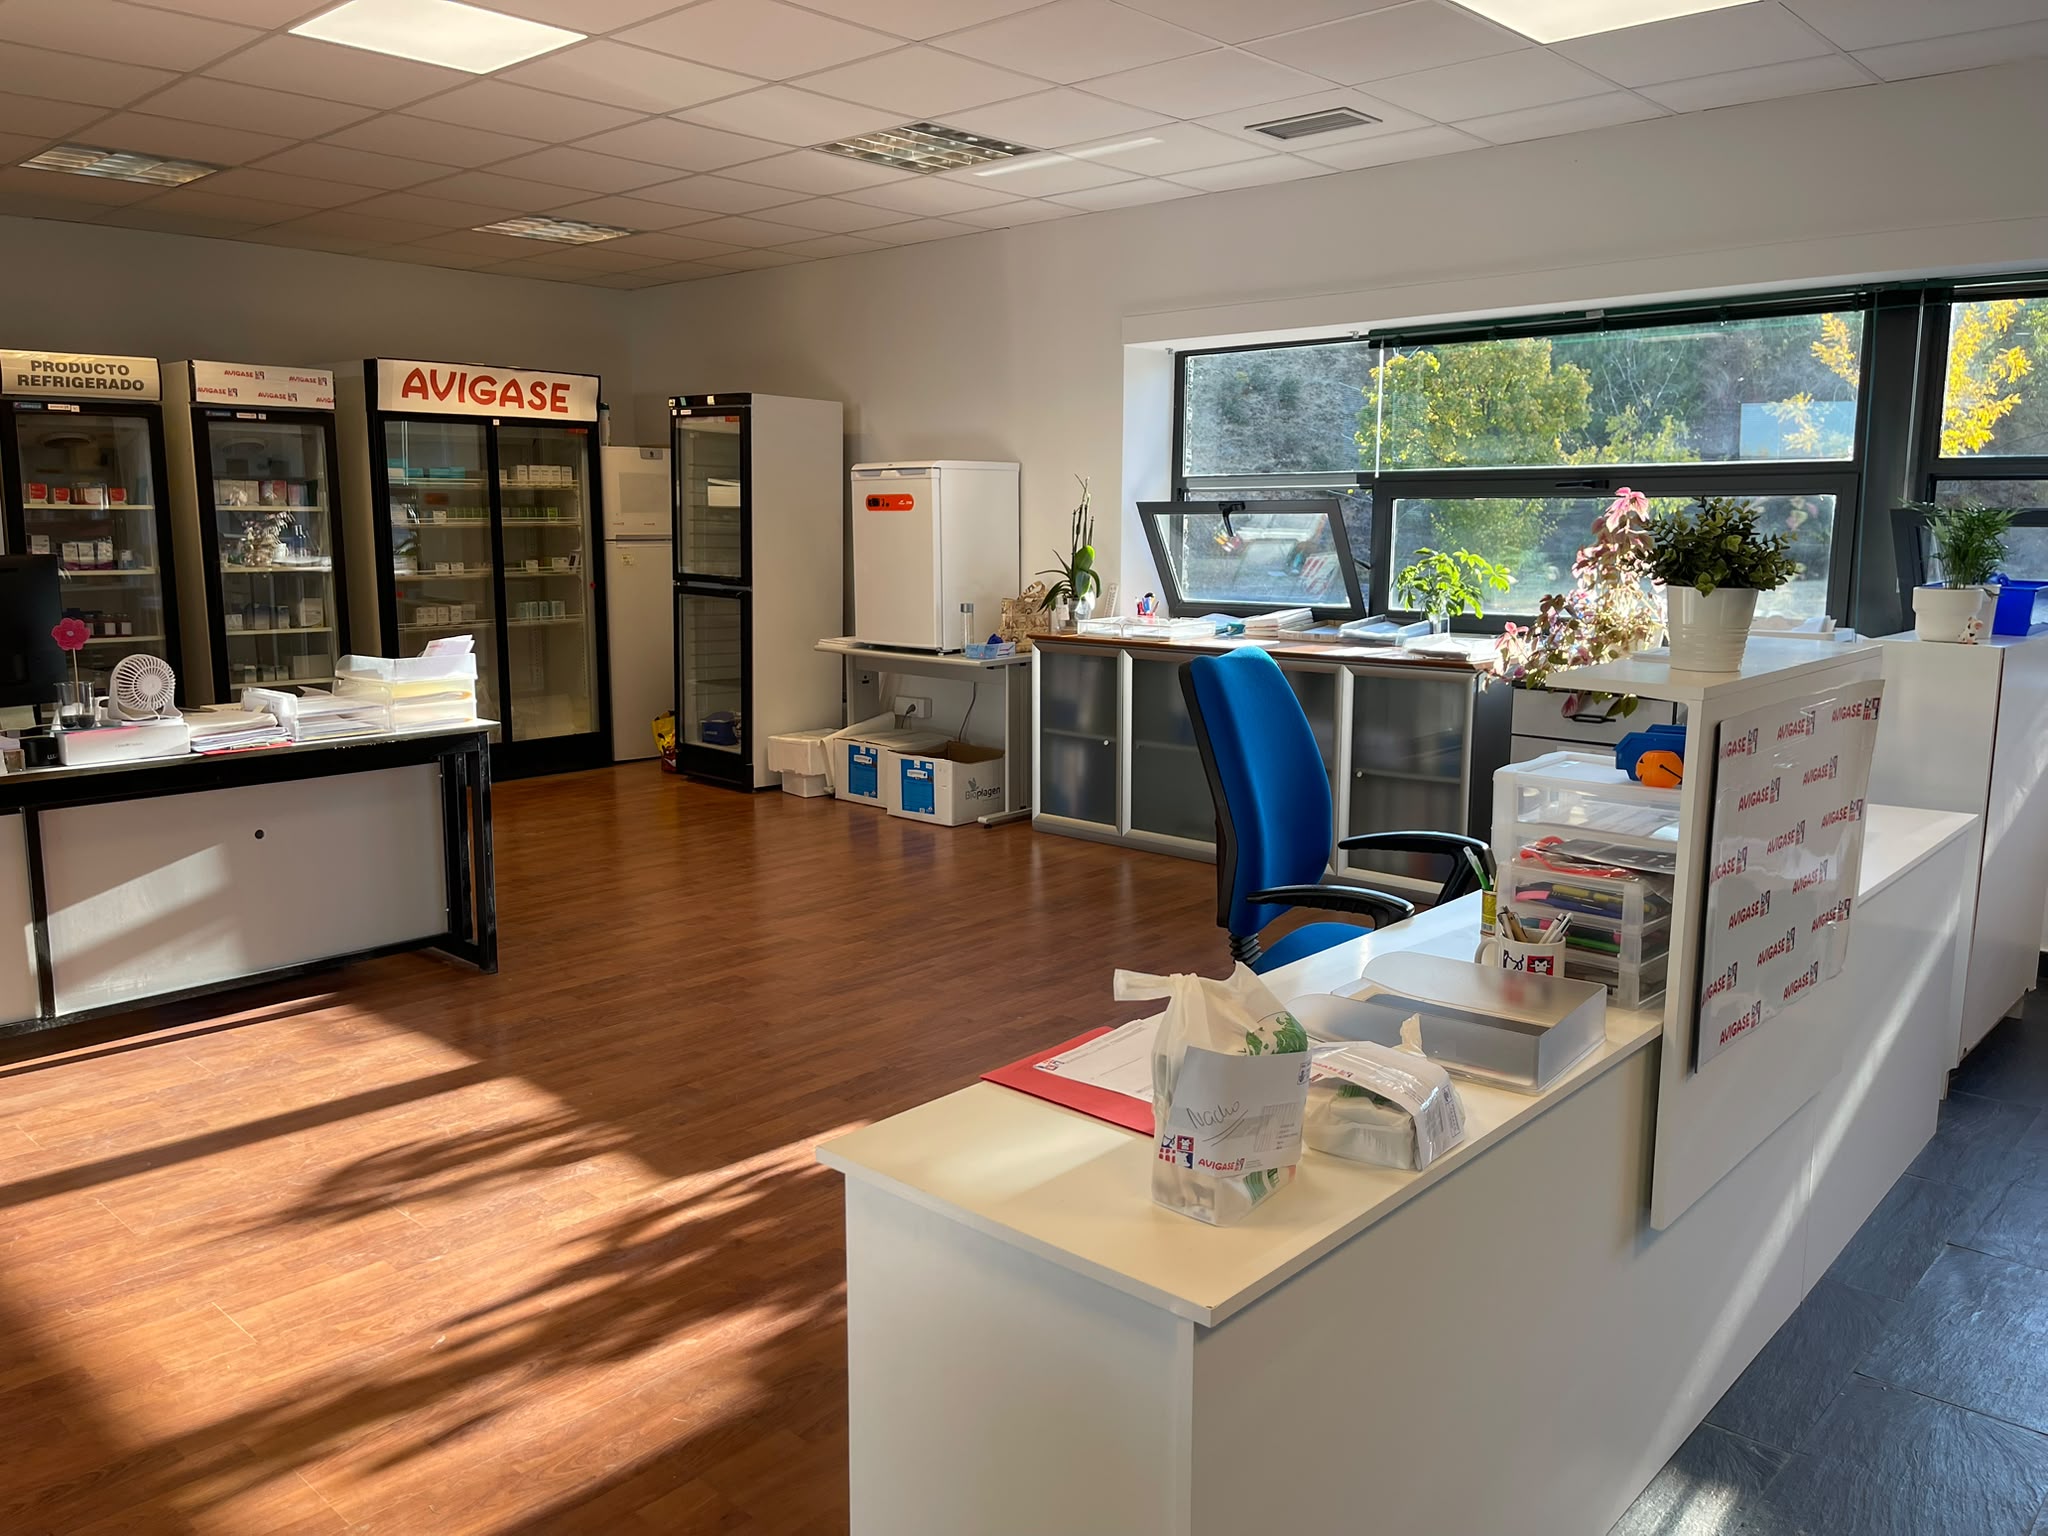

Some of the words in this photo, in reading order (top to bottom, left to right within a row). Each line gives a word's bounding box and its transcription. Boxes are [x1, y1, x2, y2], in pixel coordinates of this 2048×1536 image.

[31, 360, 130, 376] PRODUCTO
[224, 369, 254, 379] AVIGASE
[288, 375, 317, 384] AVIGASE
[17, 374, 145, 391] REFRIGERADO
[402, 367, 571, 414] AVIGASE
[257, 392, 287, 400] AVIGASE
[1831, 703, 1863, 722] AVIGASE
[1776, 718, 1806, 741] AVIGASE
[1802, 763, 1829, 786] AVIGASE
[1737, 785, 1770, 812] AVIGASE
[1820, 805, 1849, 829] AVIGASE
[1766, 828, 1796, 855] AVIGASE
[1791, 868, 1819, 895] AVIGASE
[1728, 900, 1761, 930] AVIGASE
[1810, 907, 1838, 933] AVIGASE
[1756, 937, 1786, 968] AVIGASE
[1783, 971, 1810, 1001] AVIGASE
[1719, 1012, 1751, 1046] AVIGASE
[1185, 1100, 1241, 1130] Nacho
[1197, 1158, 1236, 1172] AVIGASE
